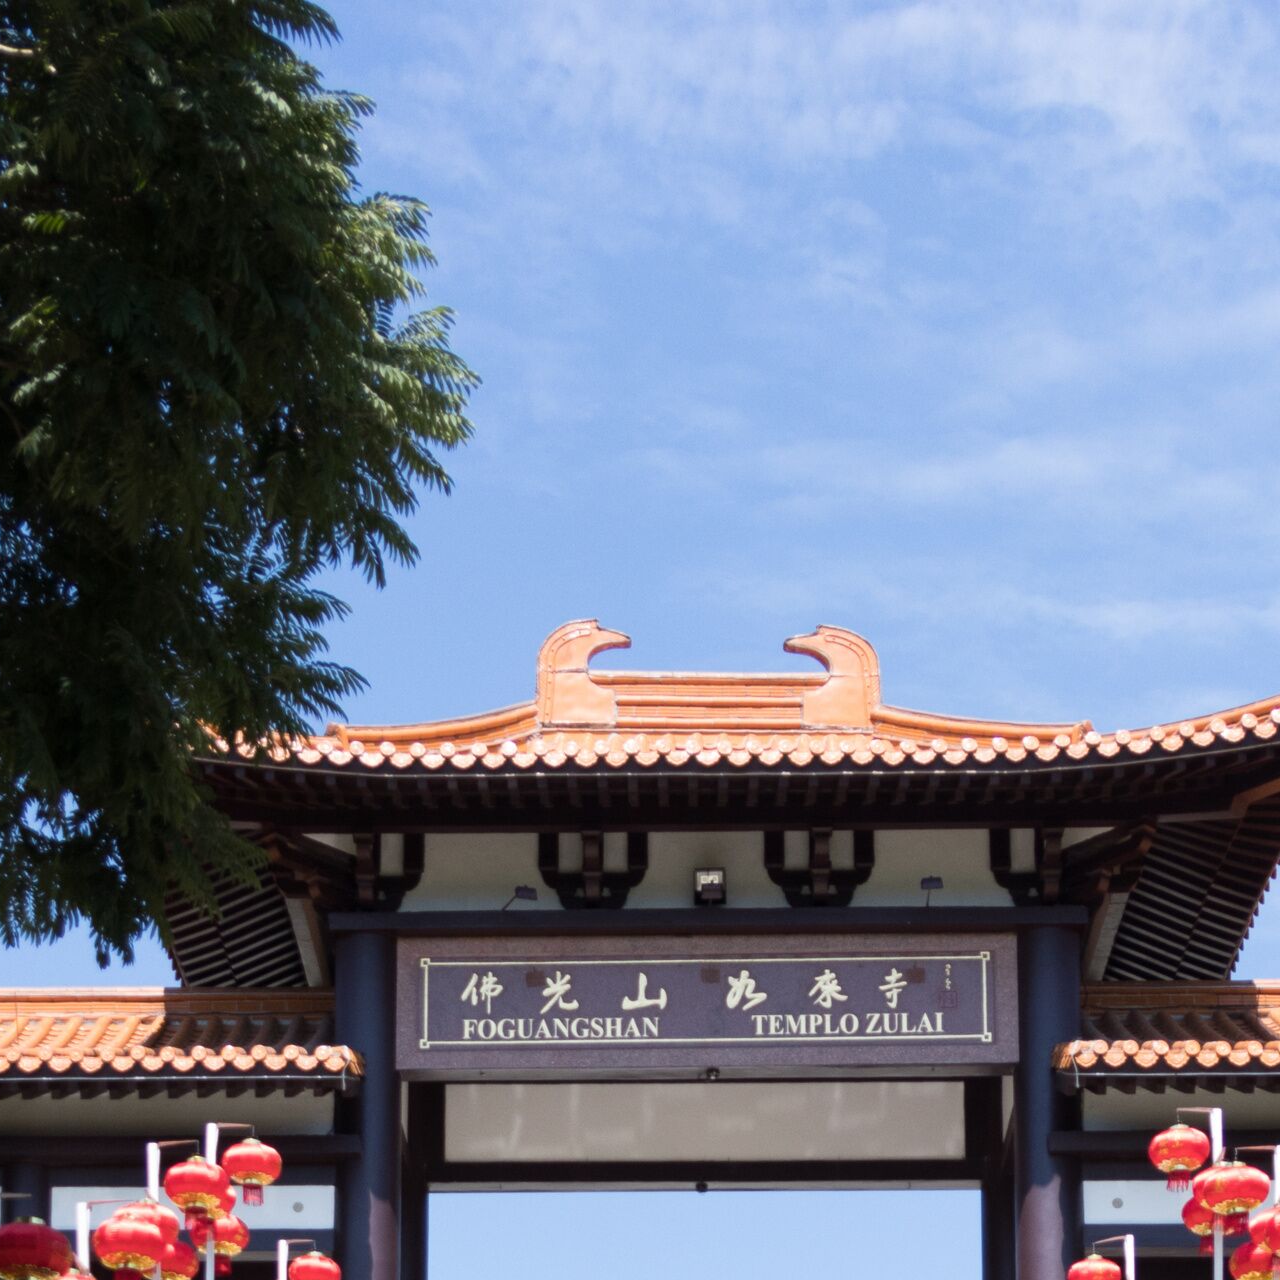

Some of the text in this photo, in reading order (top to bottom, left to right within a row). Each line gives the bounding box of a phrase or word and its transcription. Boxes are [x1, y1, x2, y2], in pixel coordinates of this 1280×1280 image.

[460, 970, 668, 1015] 佛光山
[462, 1016, 660, 1040] FOGUANGSHAN
[751, 1011, 945, 1036] TEMPLO ZULAI
